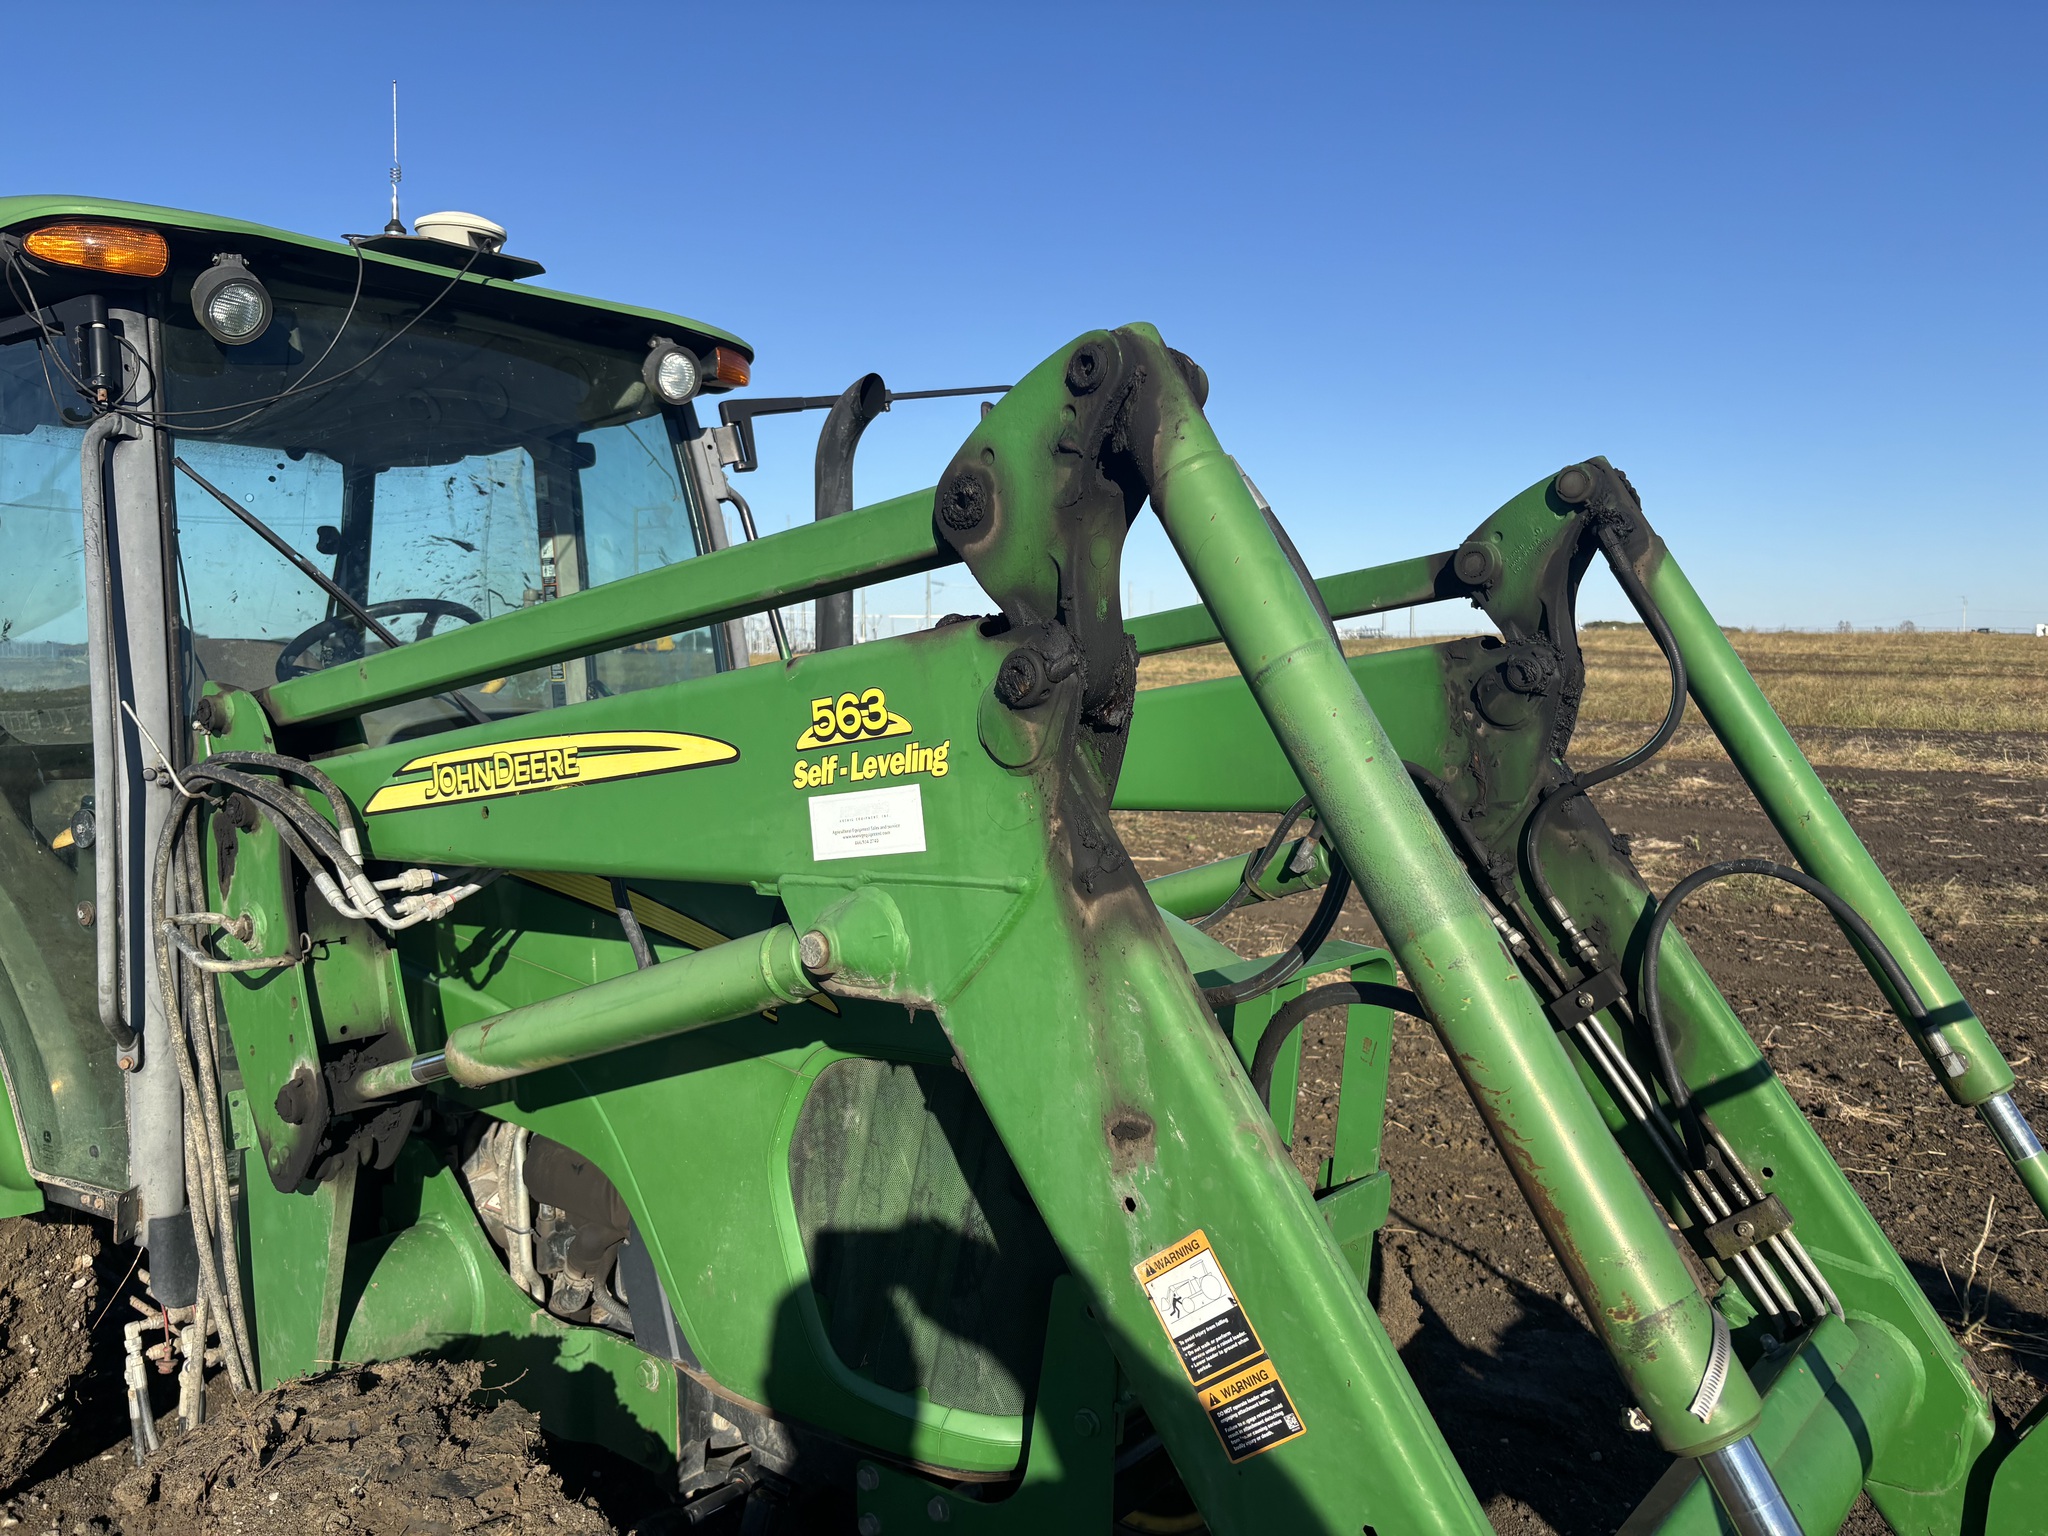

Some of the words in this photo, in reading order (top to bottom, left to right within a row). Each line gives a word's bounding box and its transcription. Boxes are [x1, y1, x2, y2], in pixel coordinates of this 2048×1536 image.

[811, 687, 889, 742] 563
[1154, 1239, 1200, 1270] WARNING
[1220, 1369, 1269, 1399] WARNING
[1242, 1415, 1257, 1425] egage
